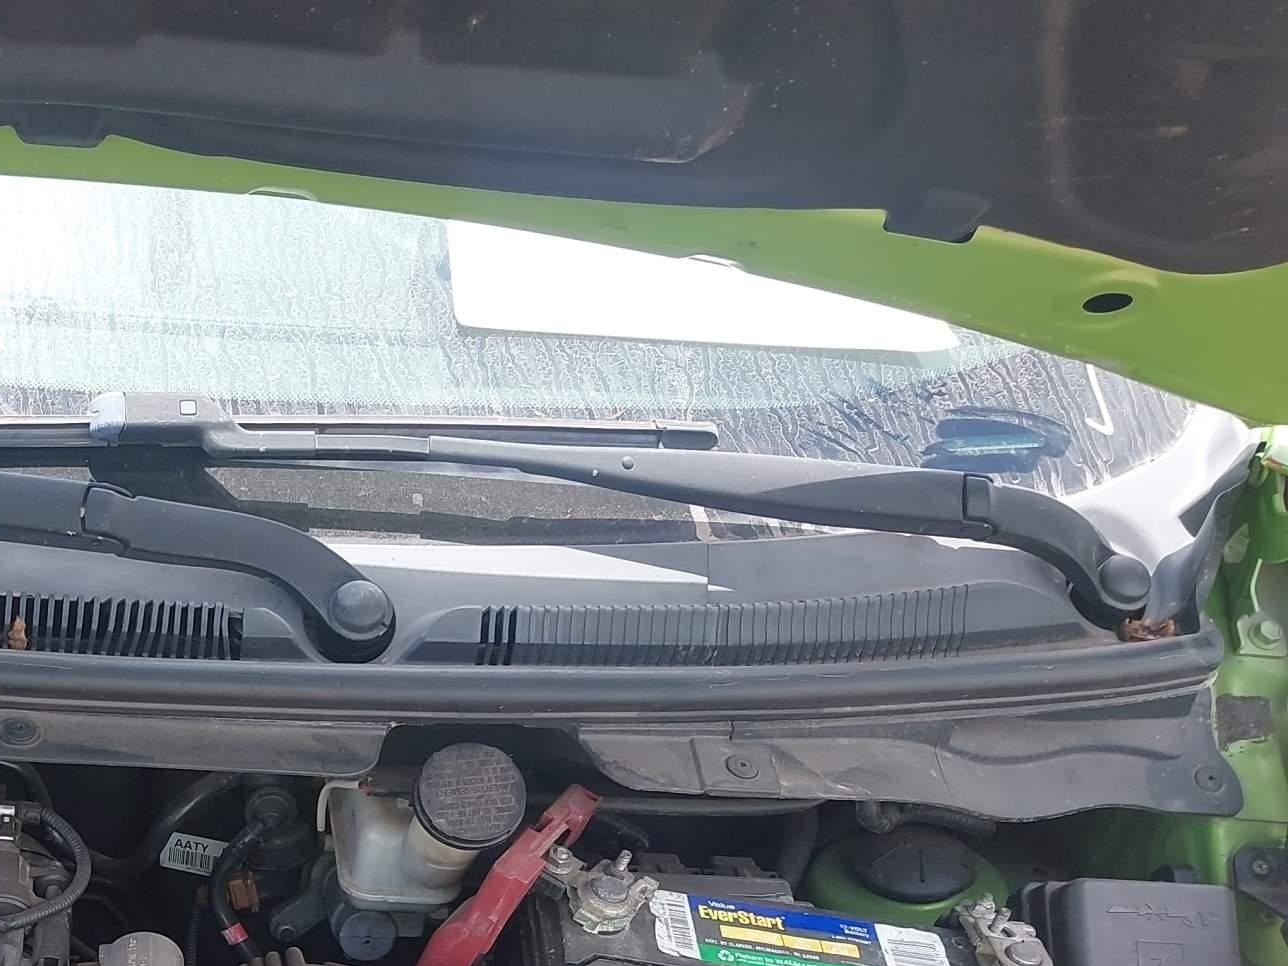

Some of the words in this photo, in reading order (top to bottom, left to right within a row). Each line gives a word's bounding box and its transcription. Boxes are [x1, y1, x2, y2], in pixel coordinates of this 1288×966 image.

[175, 838, 209, 853] AATY
[708, 900, 736, 910] Value
[698, 904, 785, 931] EverStart
[735, 952, 764, 962] Return
